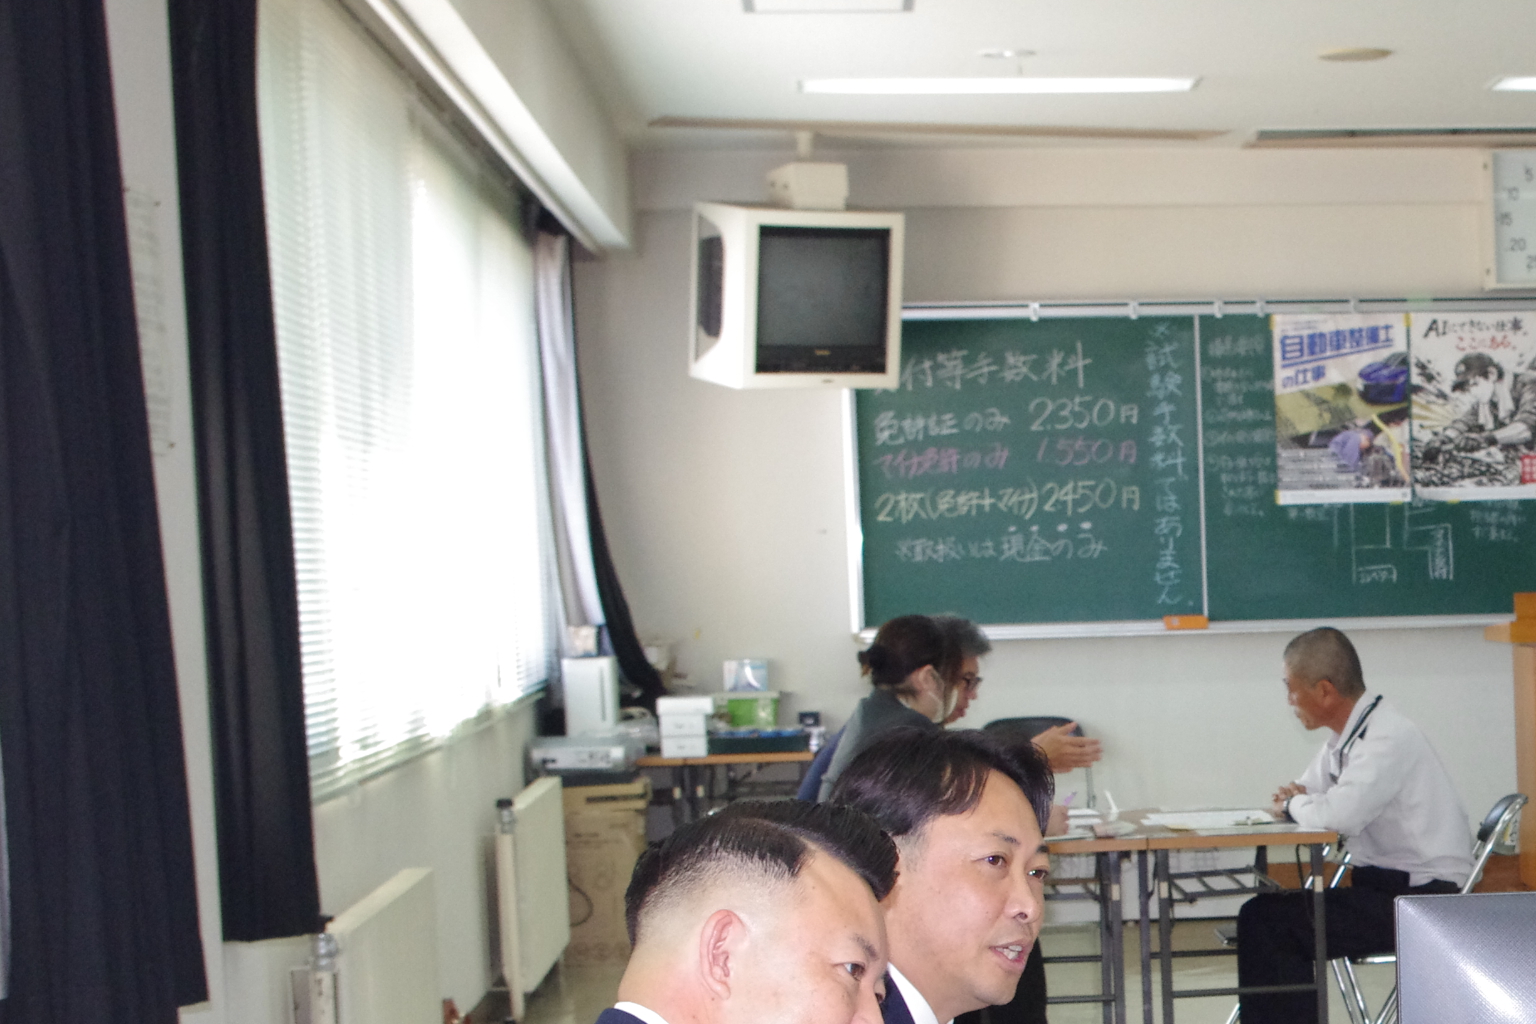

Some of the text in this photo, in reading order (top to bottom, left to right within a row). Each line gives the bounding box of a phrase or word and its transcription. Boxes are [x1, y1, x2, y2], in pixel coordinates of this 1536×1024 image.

[1510, 237, 1527, 252] 20
[876, 341, 1093, 394] 付等手数料
